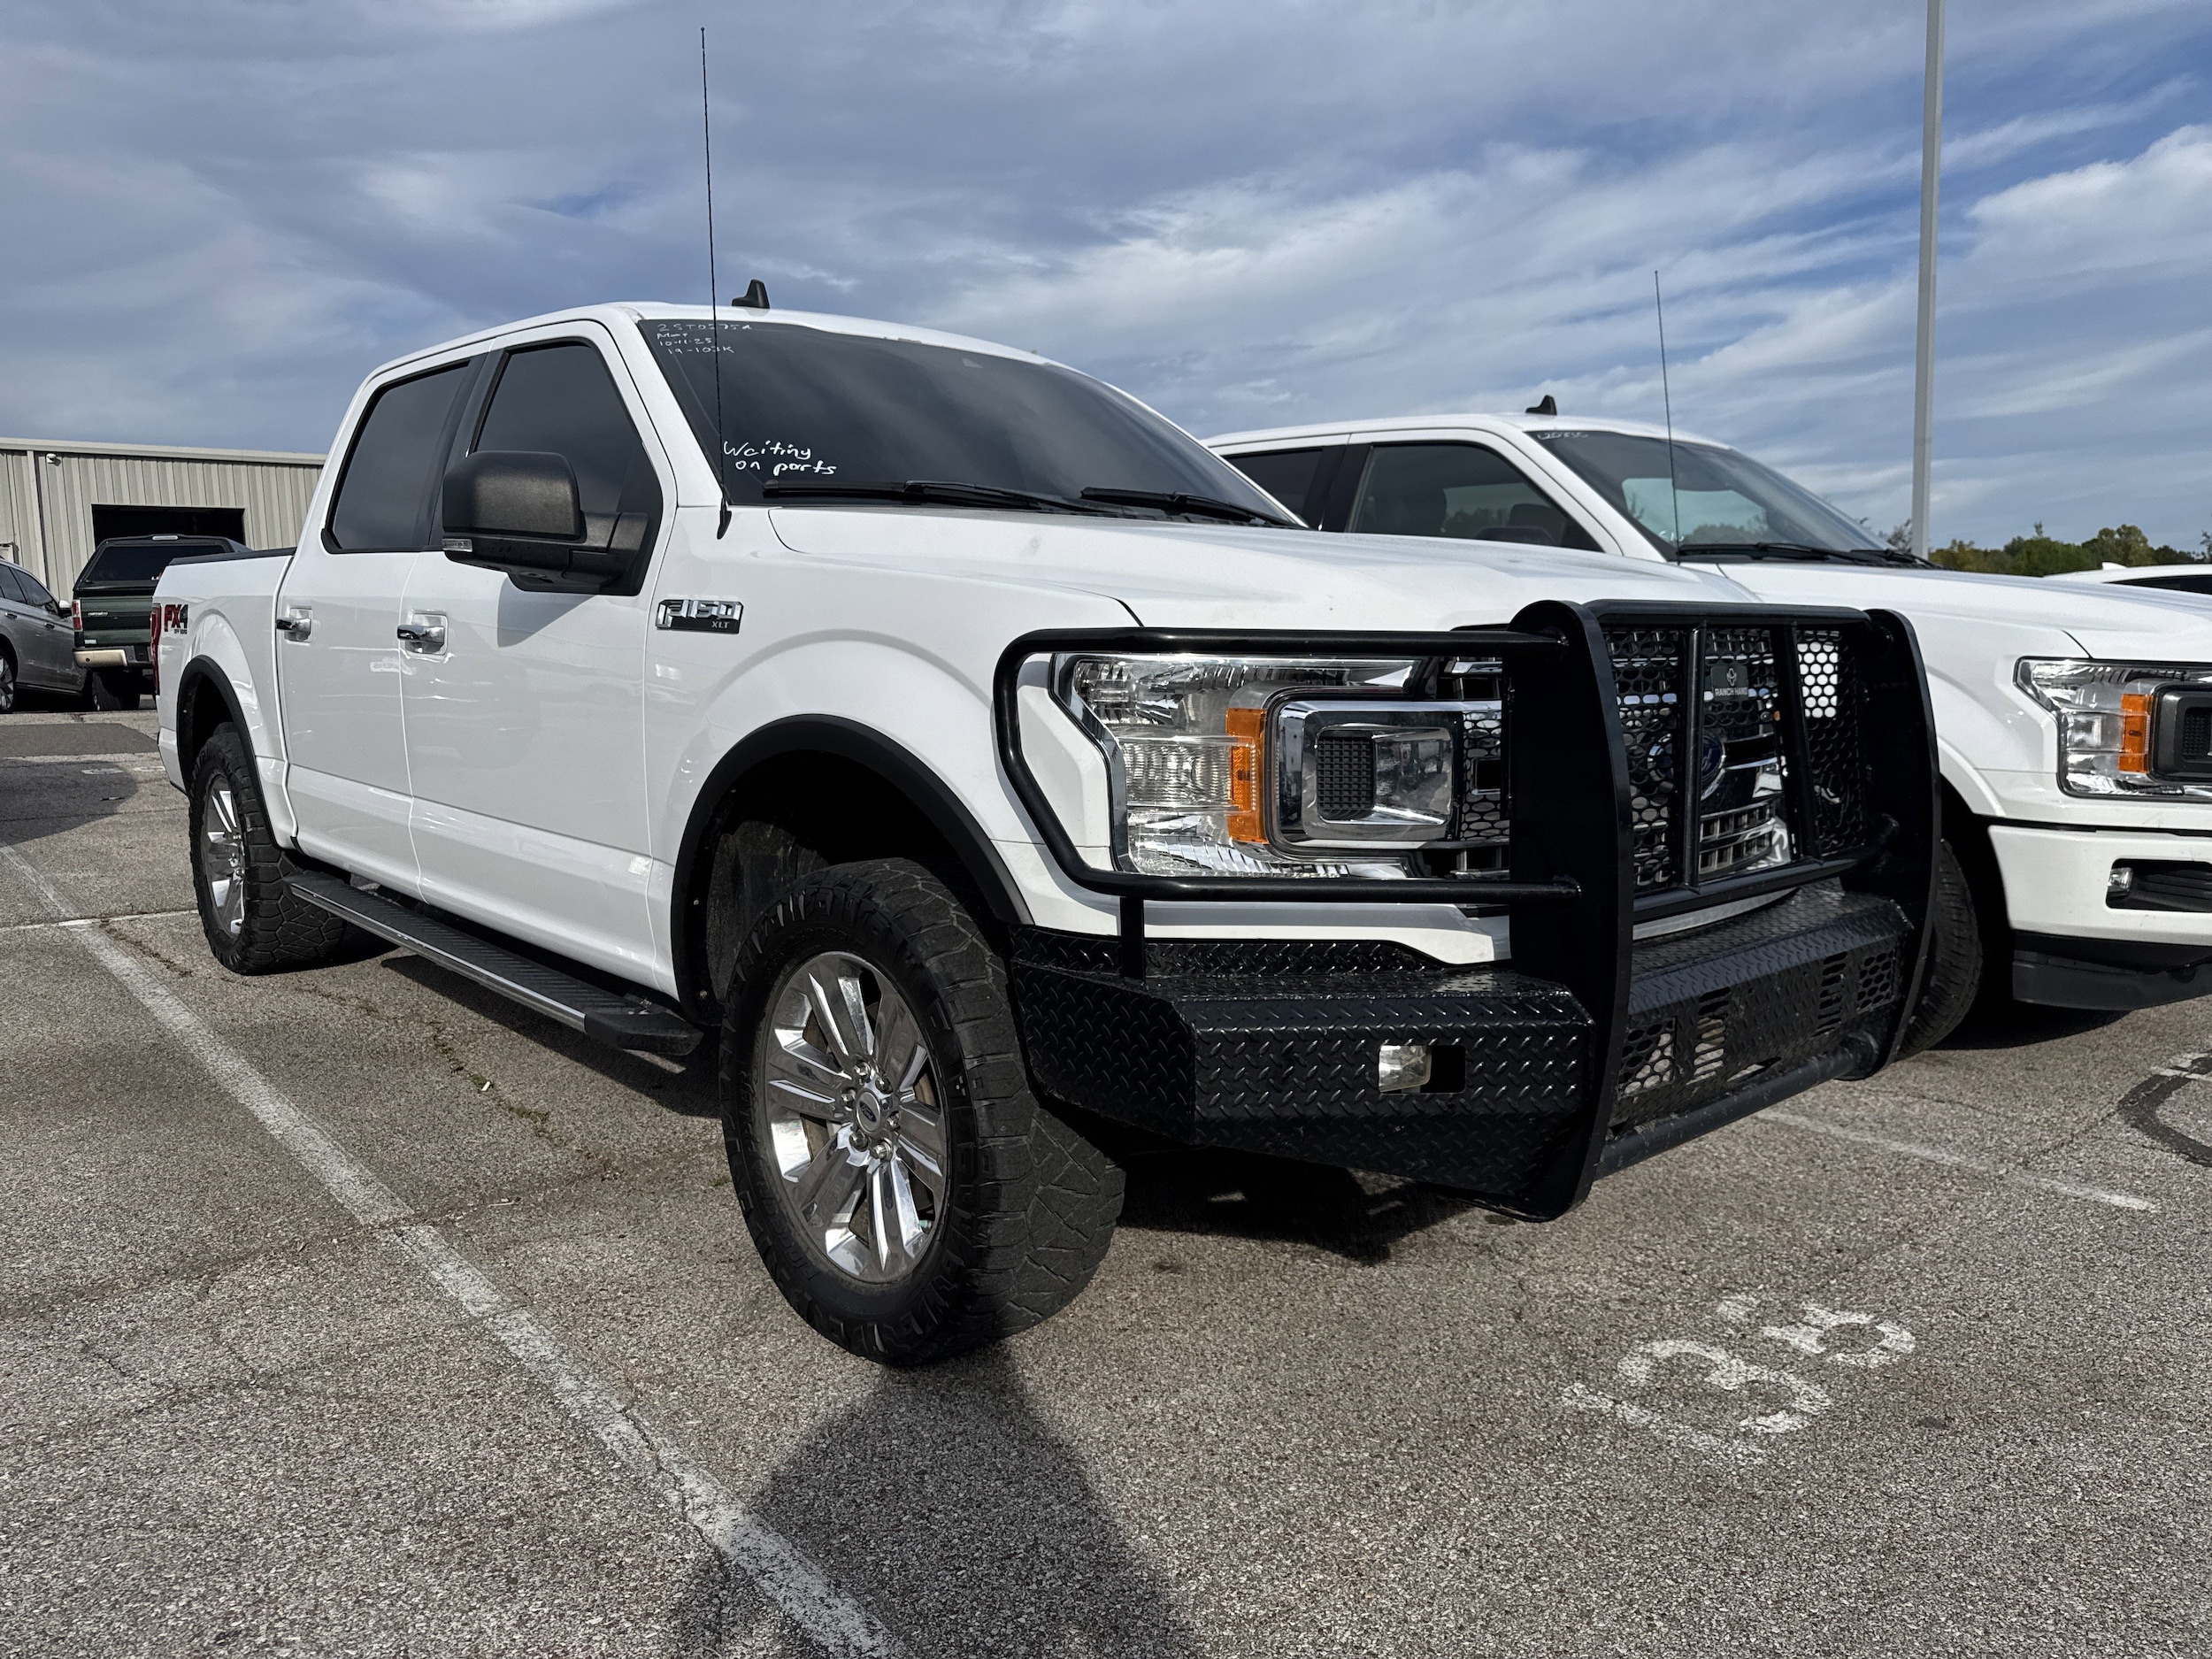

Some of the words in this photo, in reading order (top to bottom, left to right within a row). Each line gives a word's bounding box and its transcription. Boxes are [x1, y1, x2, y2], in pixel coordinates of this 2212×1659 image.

[724, 441, 811, 459] Waiting
[735, 460, 761, 471] on
[772, 460, 837, 476] parts
[164, 603, 188, 632] FX4
[711, 620, 731, 629] XLT
[1715, 687, 1734, 696] RANCH
[1734, 687, 1748, 695] HAND
